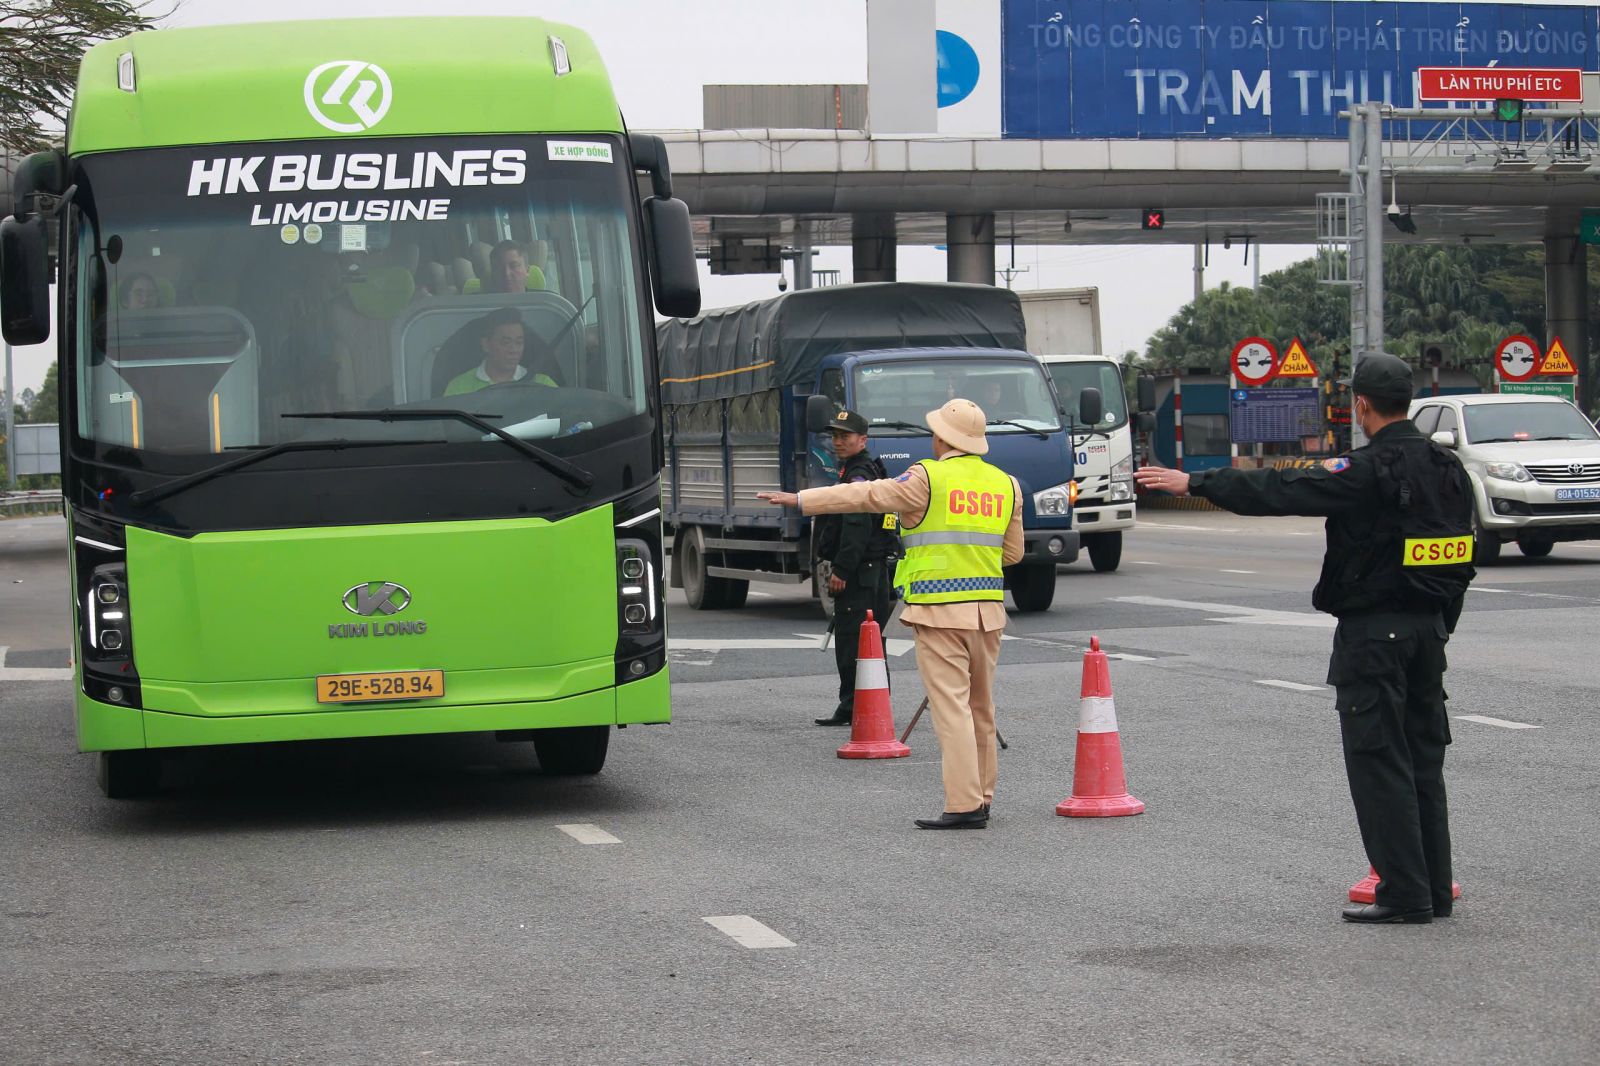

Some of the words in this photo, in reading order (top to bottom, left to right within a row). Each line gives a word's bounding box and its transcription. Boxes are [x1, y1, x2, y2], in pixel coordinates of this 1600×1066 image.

[1028, 12, 1100, 48] TỔNG
[1109, 17, 1182, 49] CÔNG
[1189, 25, 1221, 49] TY
[1229, 15, 1284, 49] ĐẦU
[1292, 26, 1327, 50] TƯ
[1336, 19, 1406, 51] PHÁT
[1412, 16, 1488, 53] TRIỂN
[1495, 23, 1588, 54] ĐƯỜNG
[1439, 74, 1470, 91] LÀN
[1473, 77, 1503, 91] THU
[1507, 74, 1532, 91] PHÍ
[1535, 77, 1562, 92] ETC
[1124, 69, 1272, 125] TRẠM
[554, 146, 566, 156] XE
[567, 145, 584, 158] HỢP
[187, 155, 267, 197] HK
[268, 149, 527, 193] BUSLINES
[250, 198, 451, 226] LIMOUSINE
[1291, 352, 1301, 361] ĐI
[1552, 351, 1561, 359] ĐI
[949, 489, 1005, 518] CSGT
[1557, 488, 1600, 499] 80A-015.52
[1411, 541, 1467, 561] CSCĐ
[328, 622, 369, 639] KIM
[373, 620, 427, 637] LONG
[327, 675, 433, 697] 29E-528.94
